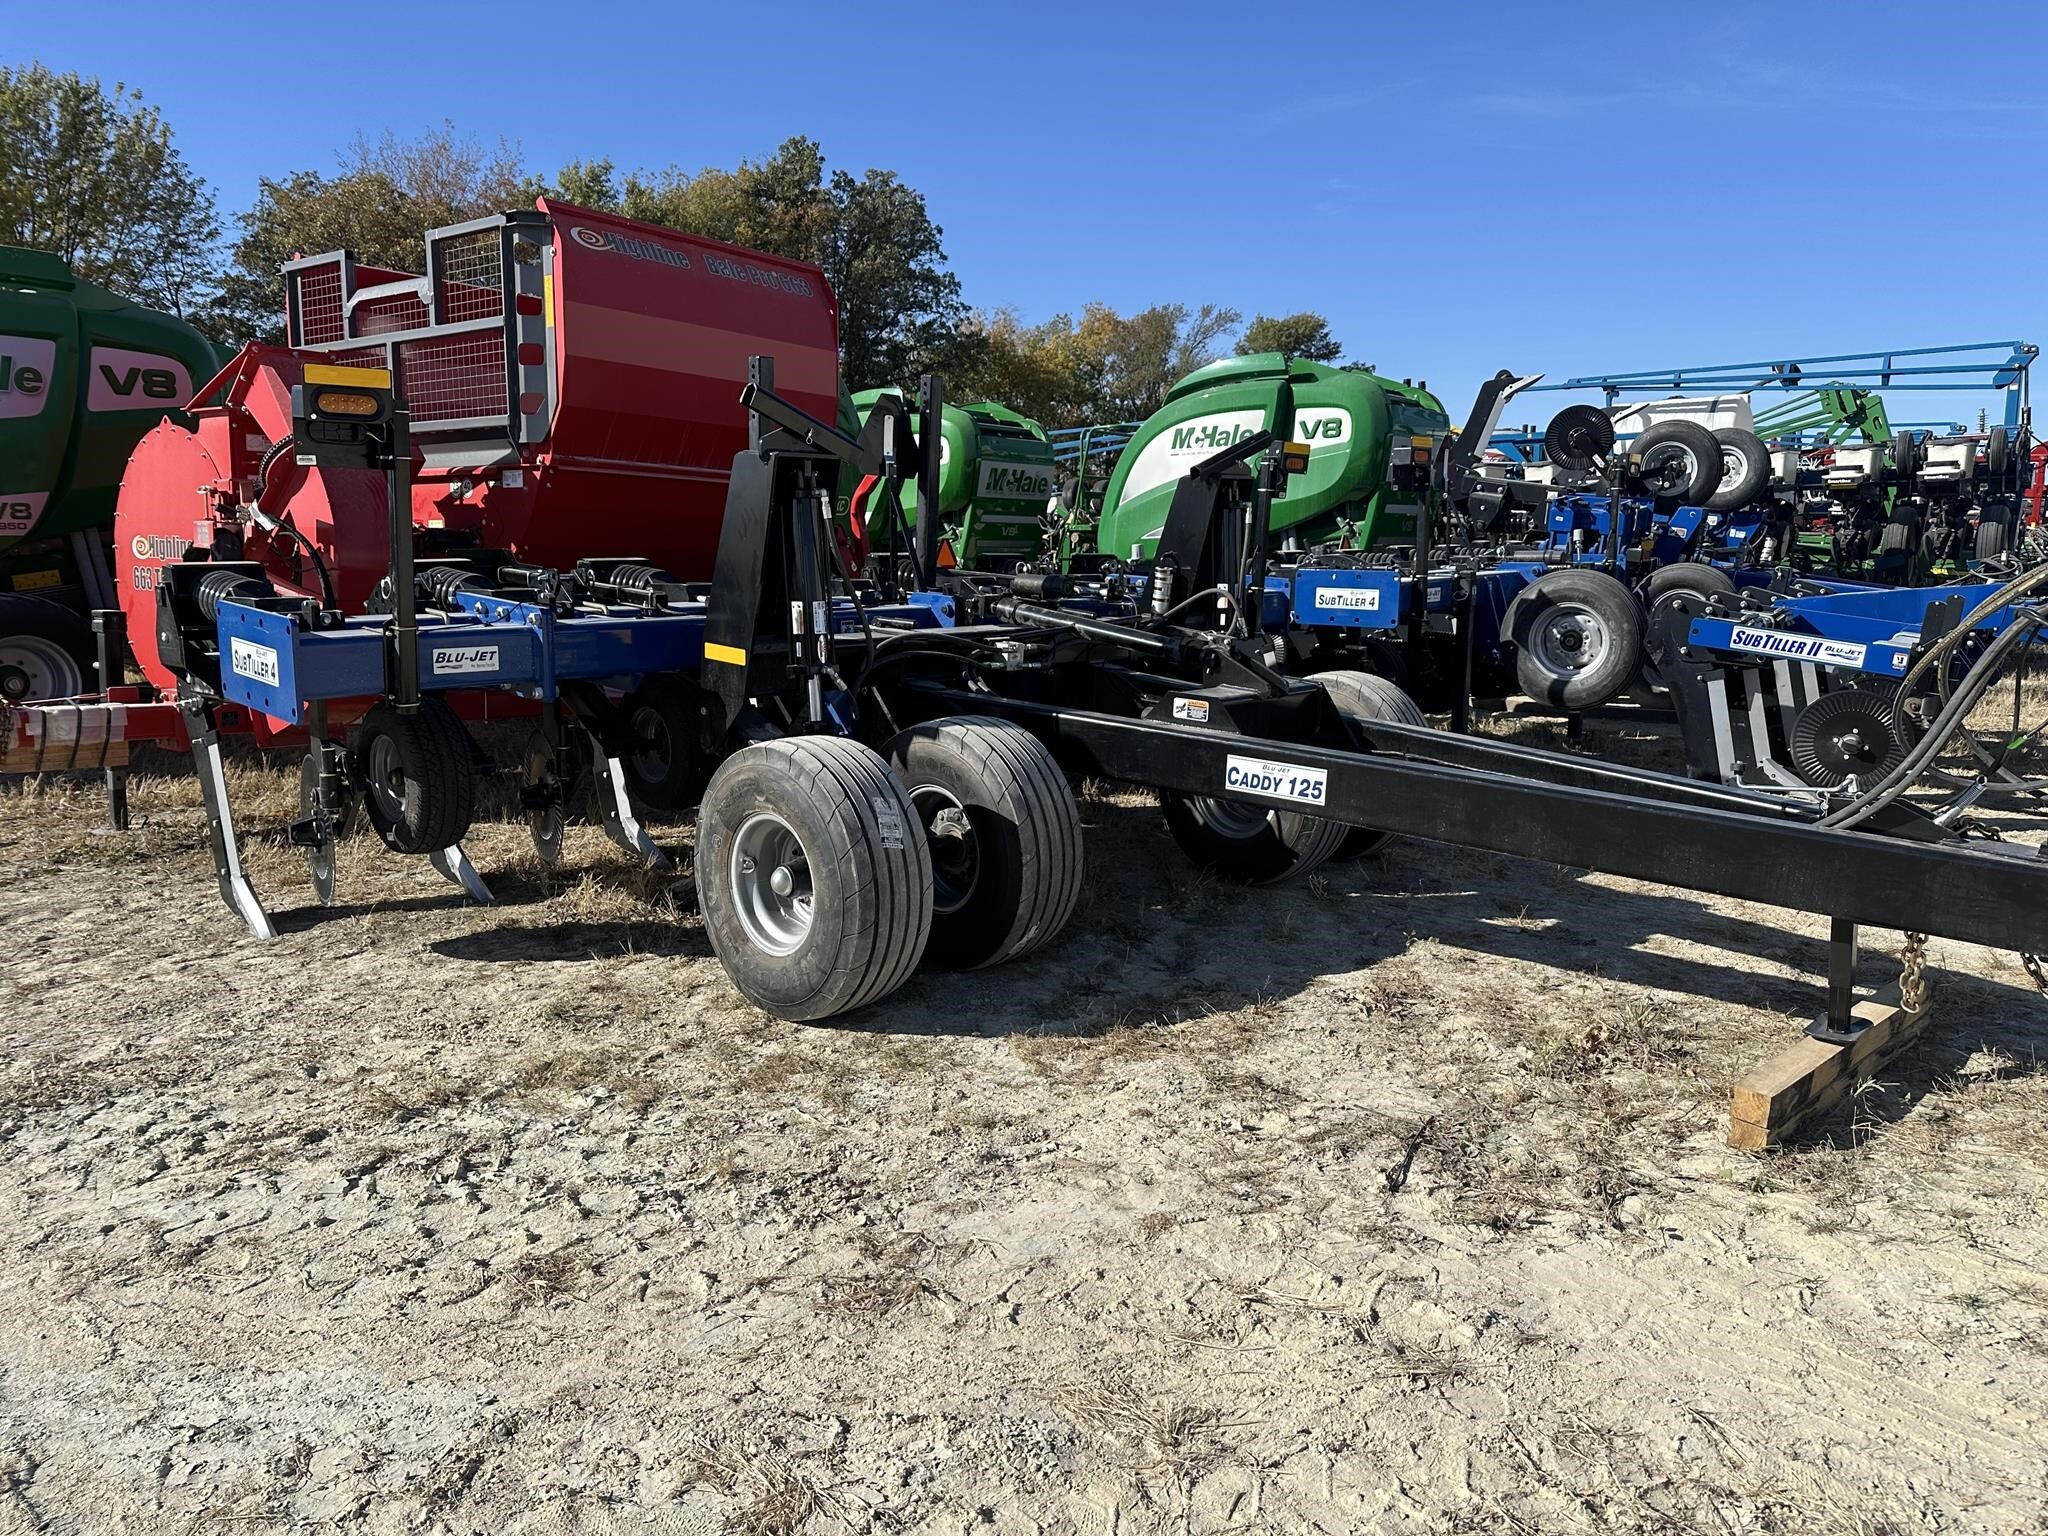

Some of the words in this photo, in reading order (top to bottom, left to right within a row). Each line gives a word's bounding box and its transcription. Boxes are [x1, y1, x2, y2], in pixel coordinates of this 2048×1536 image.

[602, 231, 690, 269] Highline
[704, 254, 746, 281] Bale
[779, 273, 813, 297] 663
[99, 365, 177, 398] V8
[1299, 418, 1342, 439] V8
[134, 567, 152, 590] 663
[1369, 597, 1375, 607] 4
[271, 662, 276, 681] 4
[1289, 777, 1324, 800] 125
